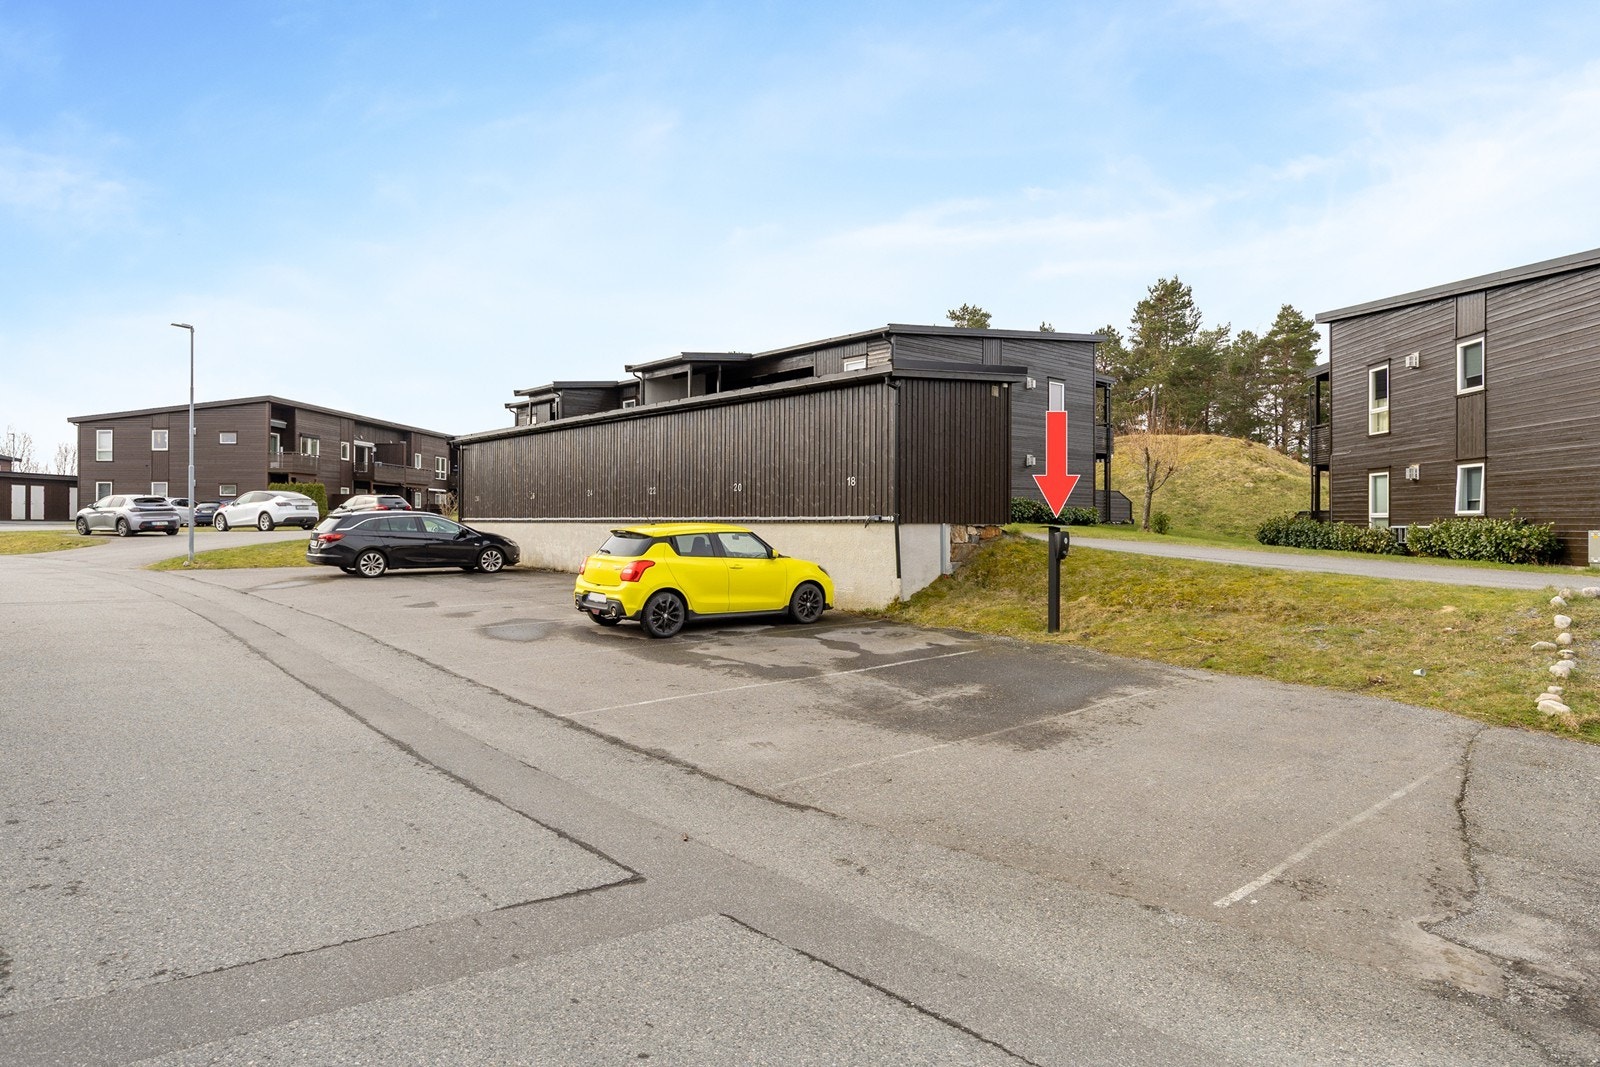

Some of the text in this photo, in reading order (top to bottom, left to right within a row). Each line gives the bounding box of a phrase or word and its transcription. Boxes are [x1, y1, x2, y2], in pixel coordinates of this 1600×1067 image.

[847, 476, 856, 487] 18
[649, 486, 657, 495] 22
[733, 483, 743, 492] 20
